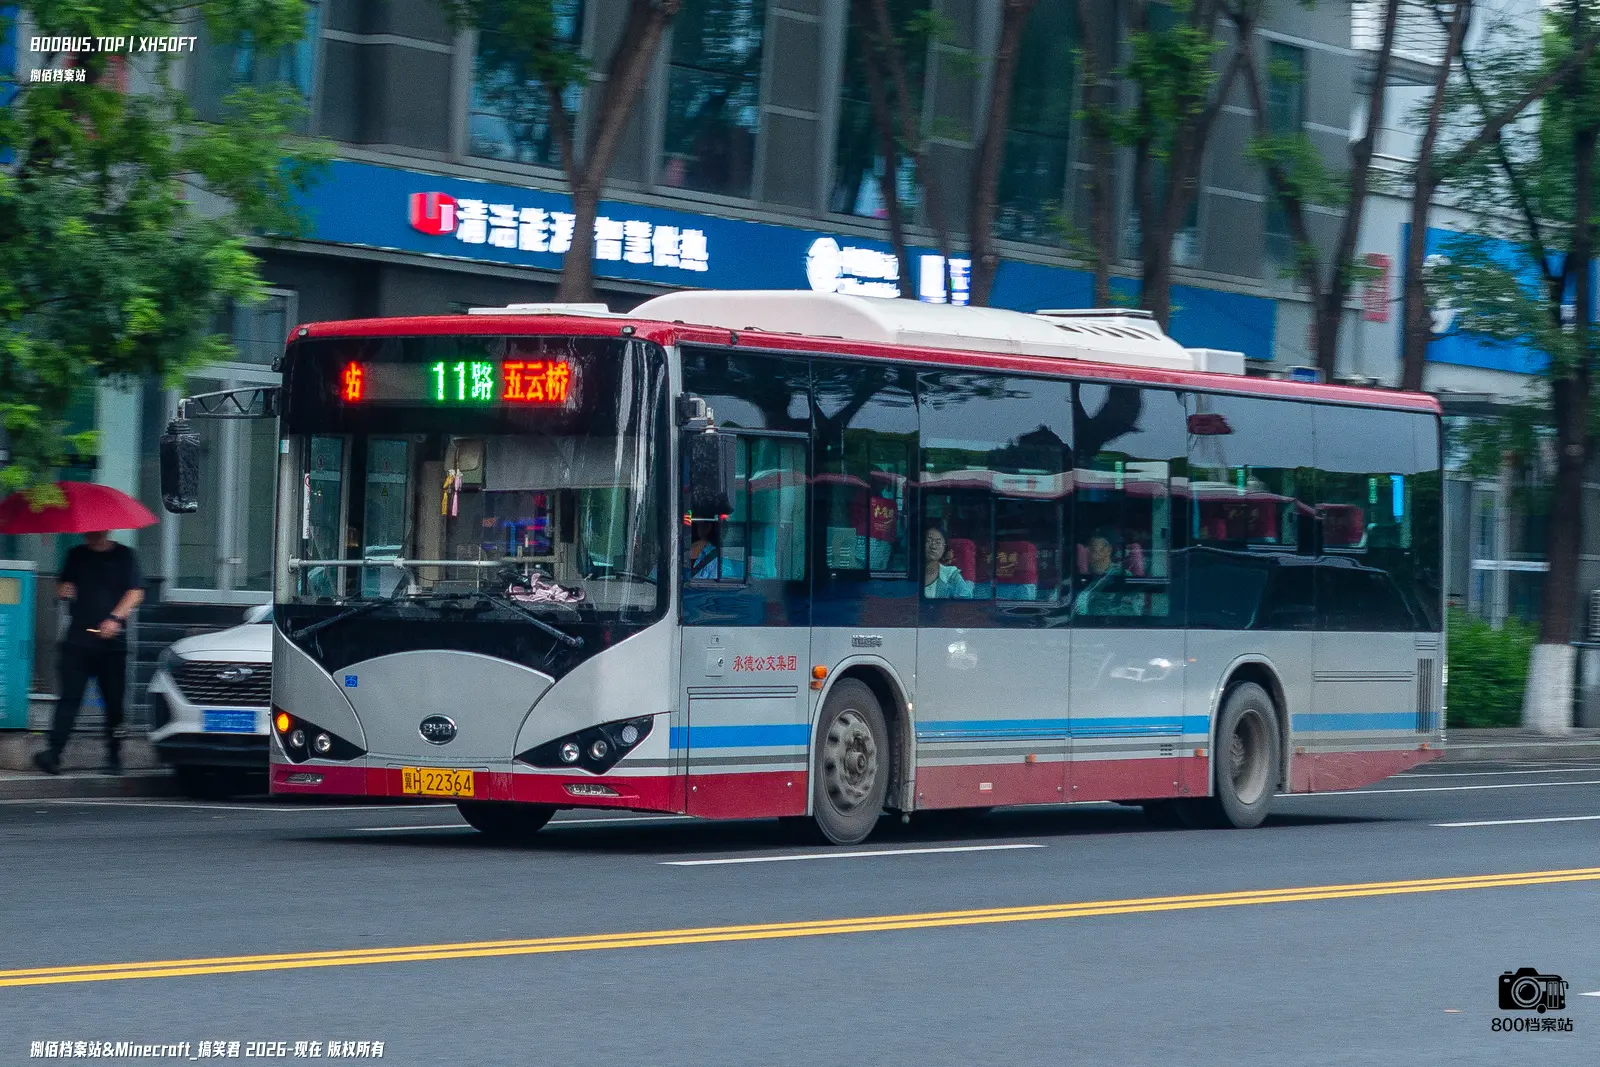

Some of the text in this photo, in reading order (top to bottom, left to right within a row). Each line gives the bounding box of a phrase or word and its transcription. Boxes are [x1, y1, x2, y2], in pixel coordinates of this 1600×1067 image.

[433, 361, 494, 400] 11路
[503, 362, 569, 400] 五云桥
[733, 655, 797, 672] 承德公交集团
[423, 723, 452, 735] BYD
